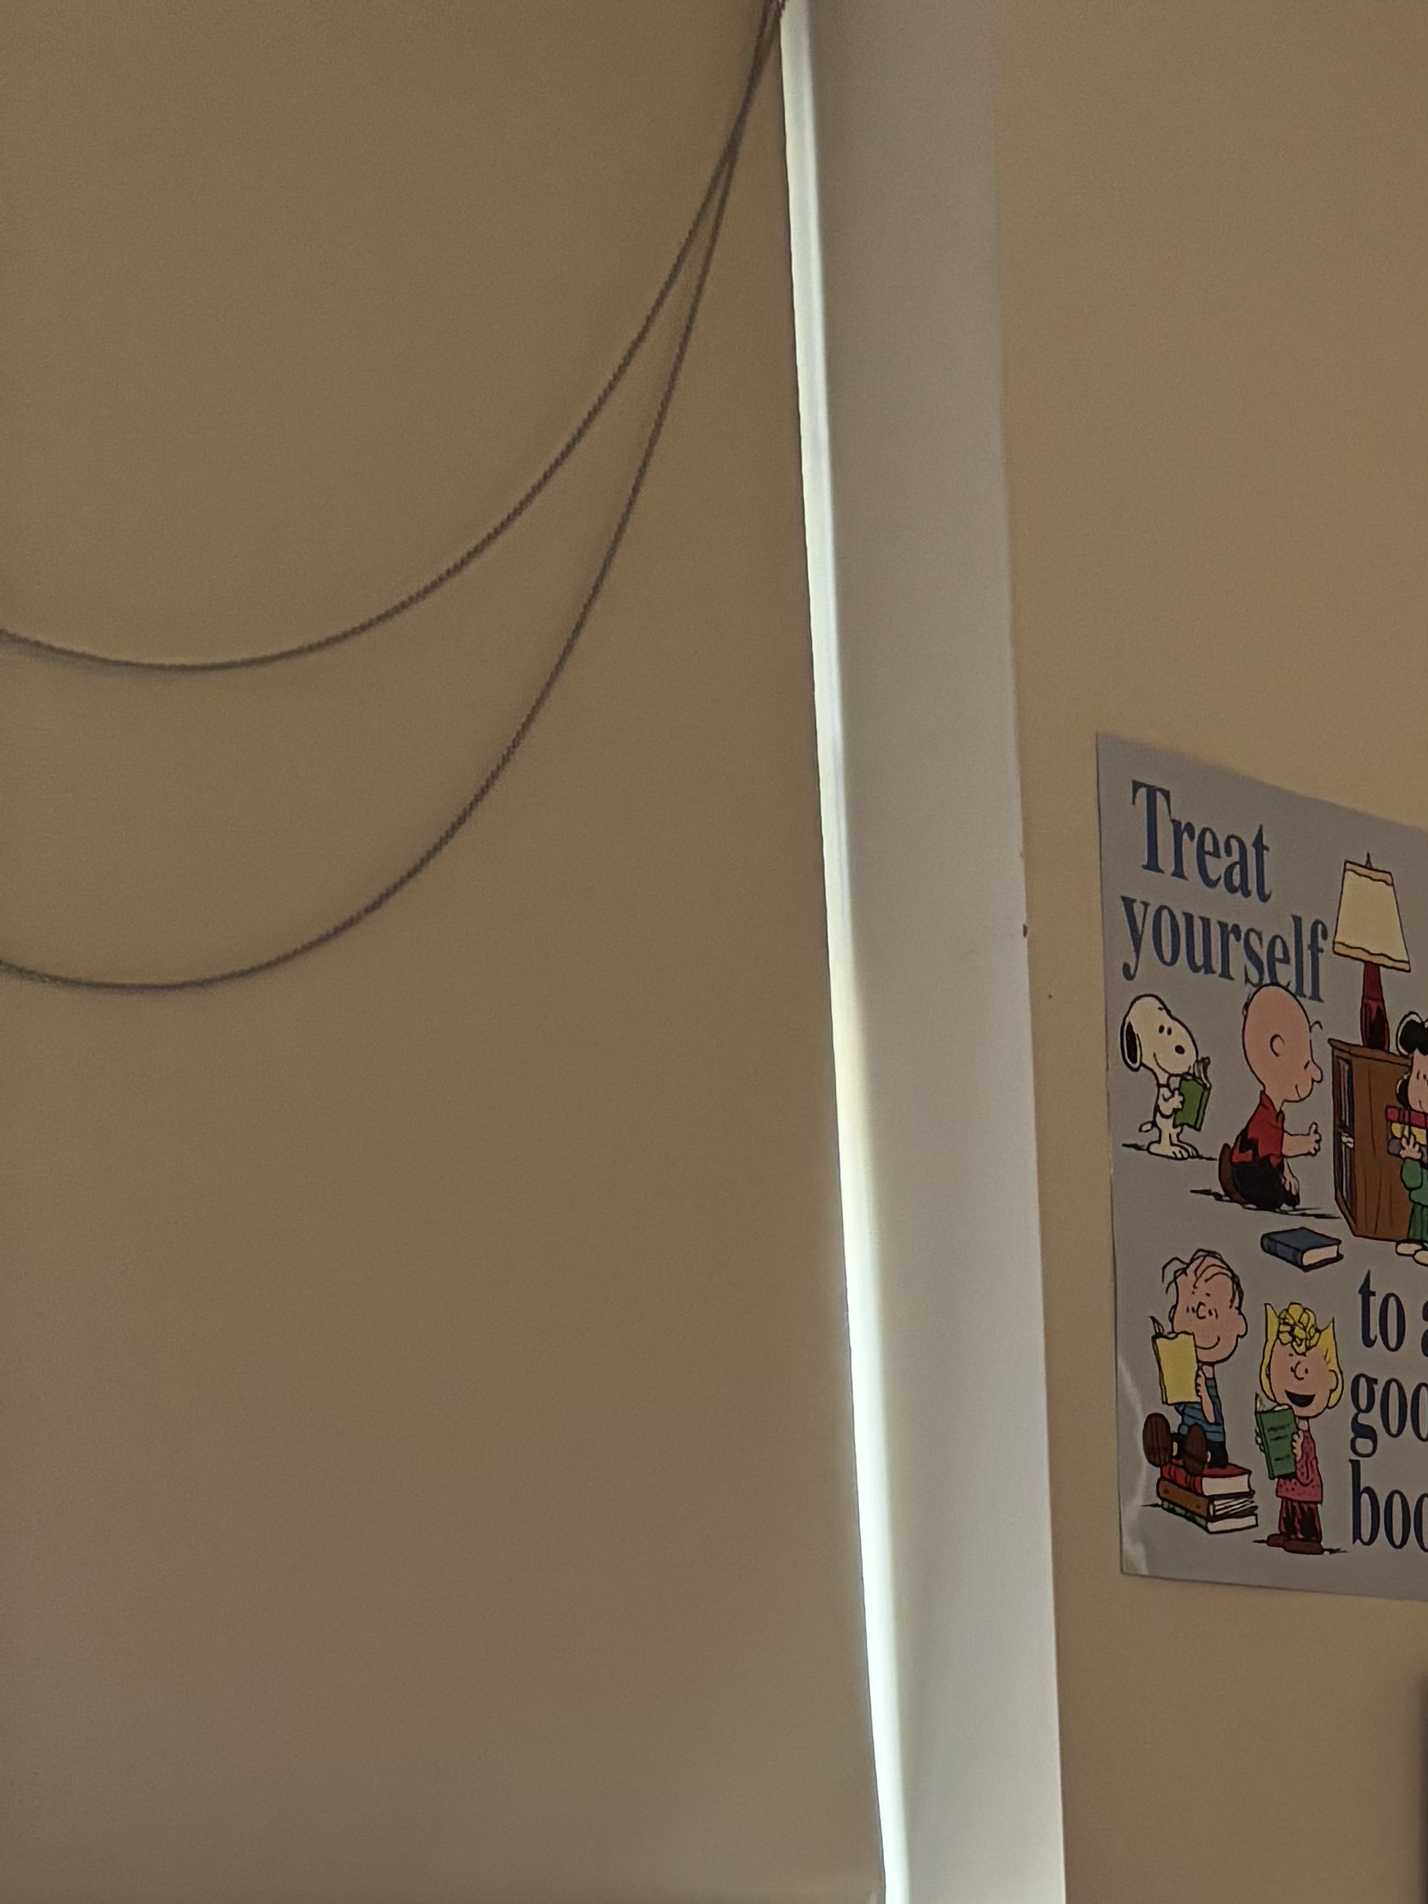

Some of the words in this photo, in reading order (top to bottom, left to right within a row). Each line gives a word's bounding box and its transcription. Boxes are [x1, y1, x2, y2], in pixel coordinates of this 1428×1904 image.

[1130, 780, 1273, 905] Treat
[1119, 894, 1329, 1002] yourself
[1359, 1270, 1406, 1352] to
